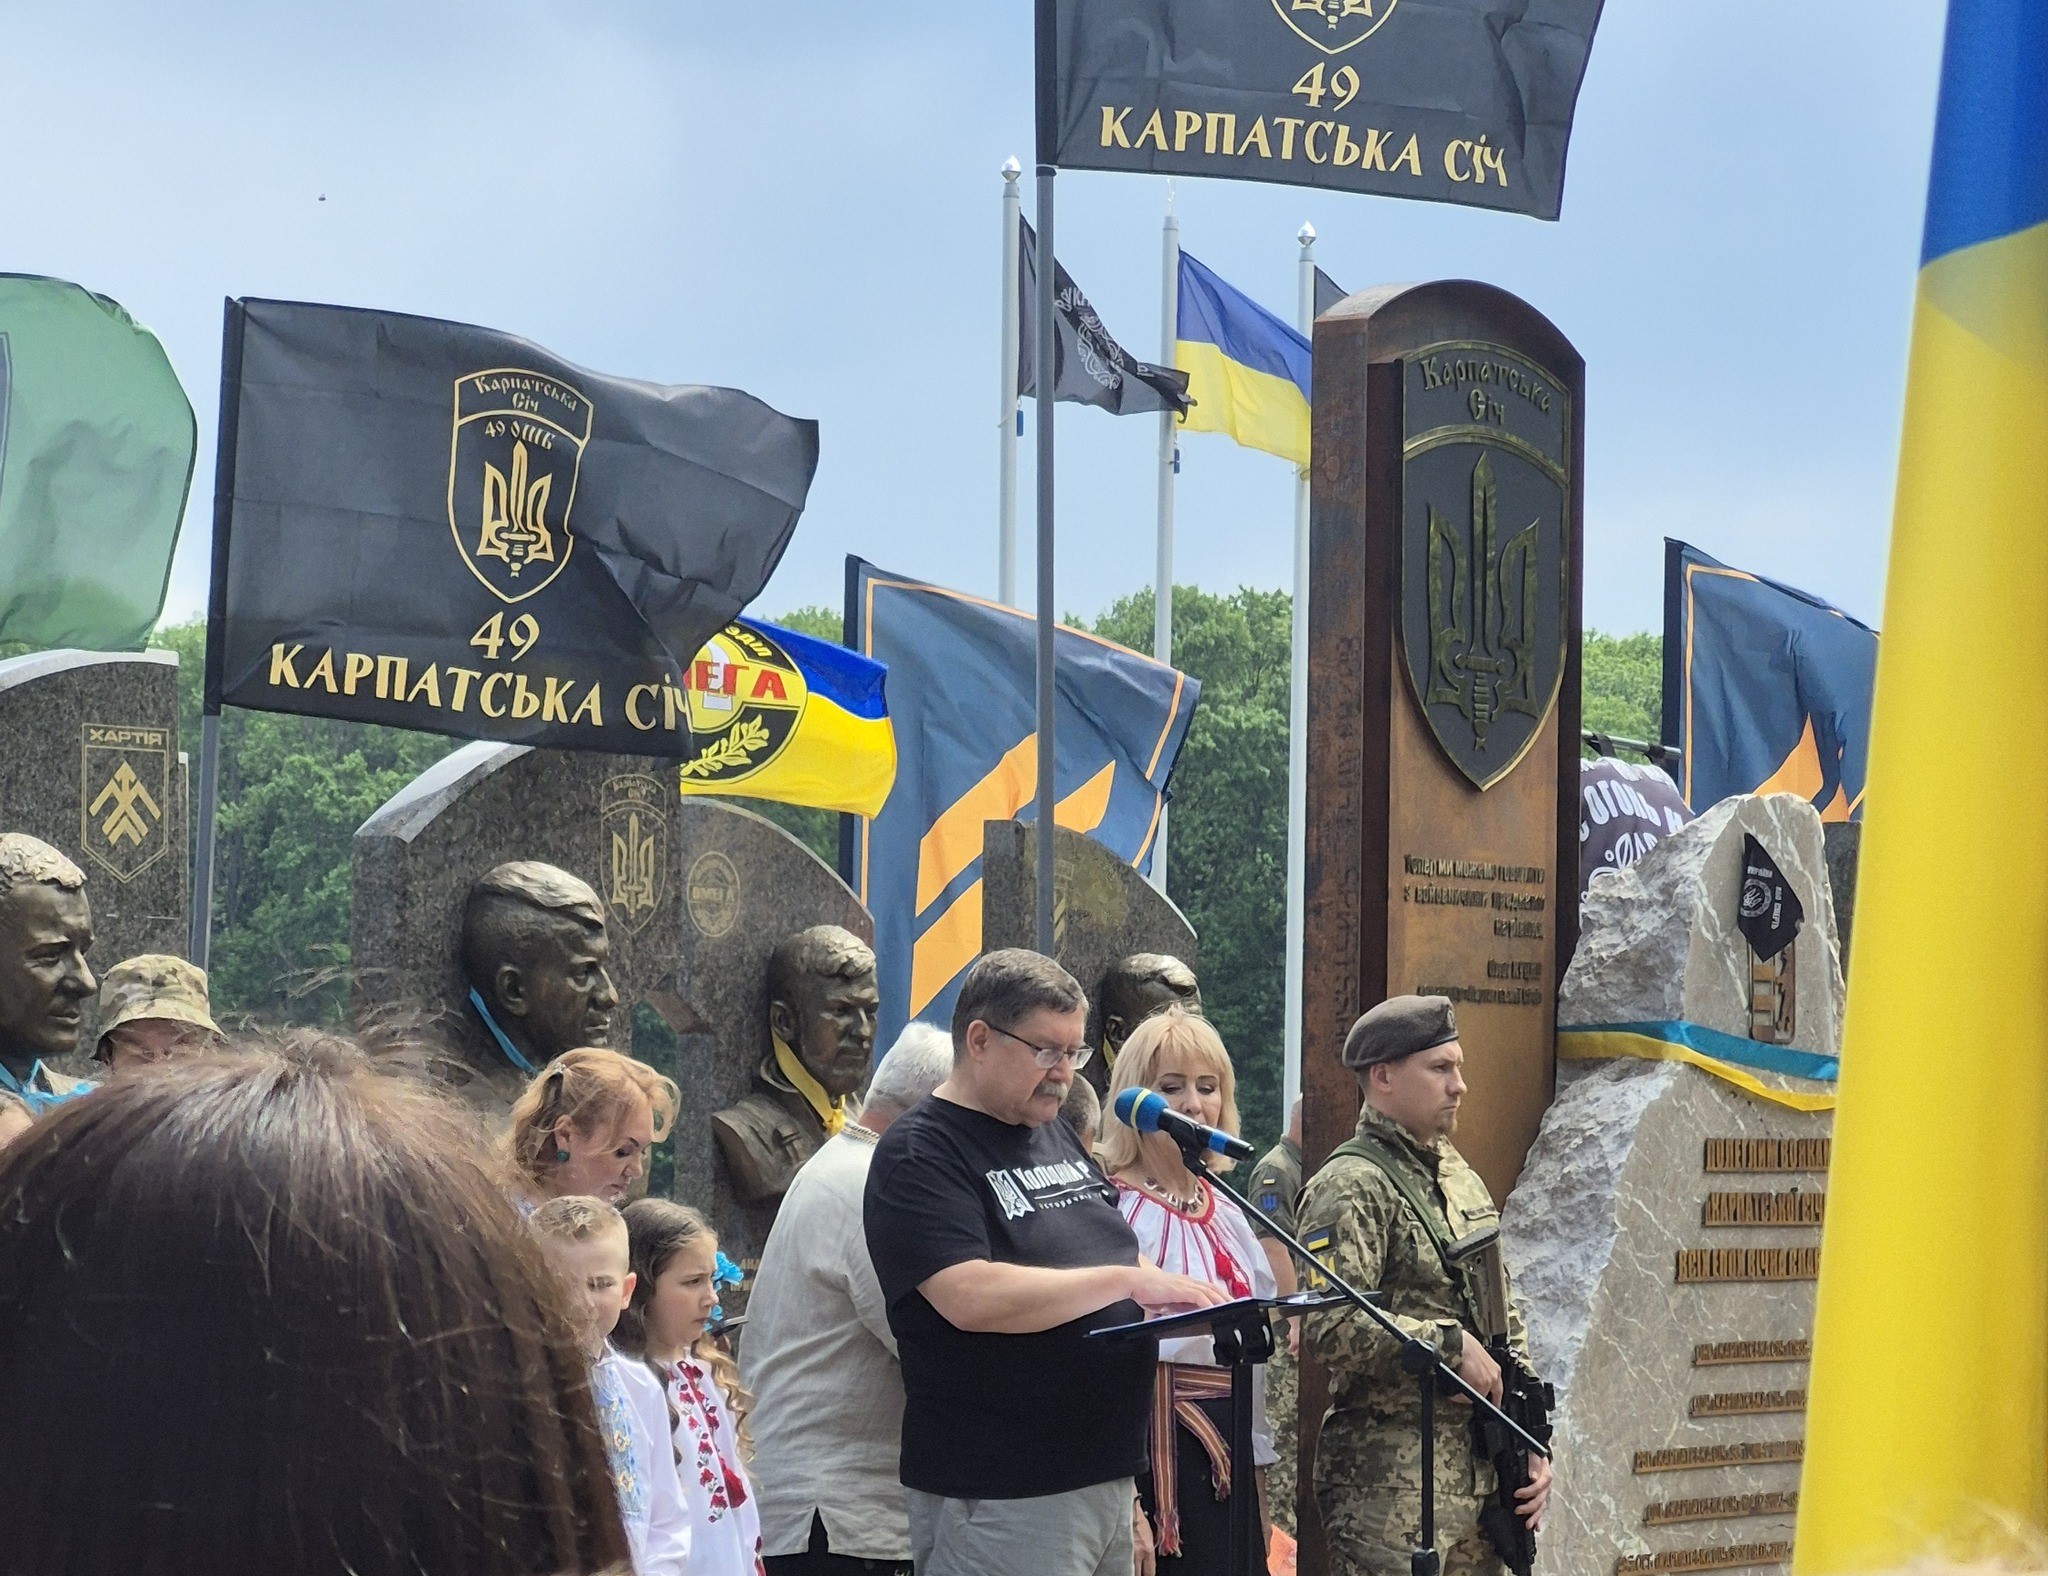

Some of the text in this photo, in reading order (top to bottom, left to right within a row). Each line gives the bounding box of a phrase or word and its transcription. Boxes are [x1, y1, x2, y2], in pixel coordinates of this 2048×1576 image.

[1291, 61, 1361, 112] 49
[1099, 106, 1422, 177] КАРПАТСЬКА
[474, 376, 578, 412] Карпатська
[512, 391, 540, 412] Січ
[1420, 356, 1551, 413] Карпатська
[1469, 388, 1505, 425] Січ
[484, 420, 506, 438] 49
[469, 610, 541, 662] 49
[268, 642, 604, 727] КАРПАТСЬКА
[89, 728, 162, 746] ХАРТІЯ
[1705, 1138, 1777, 1168] ПОЛЕГЛИМ
[1802, 1192, 1826, 1222] СІЧ
